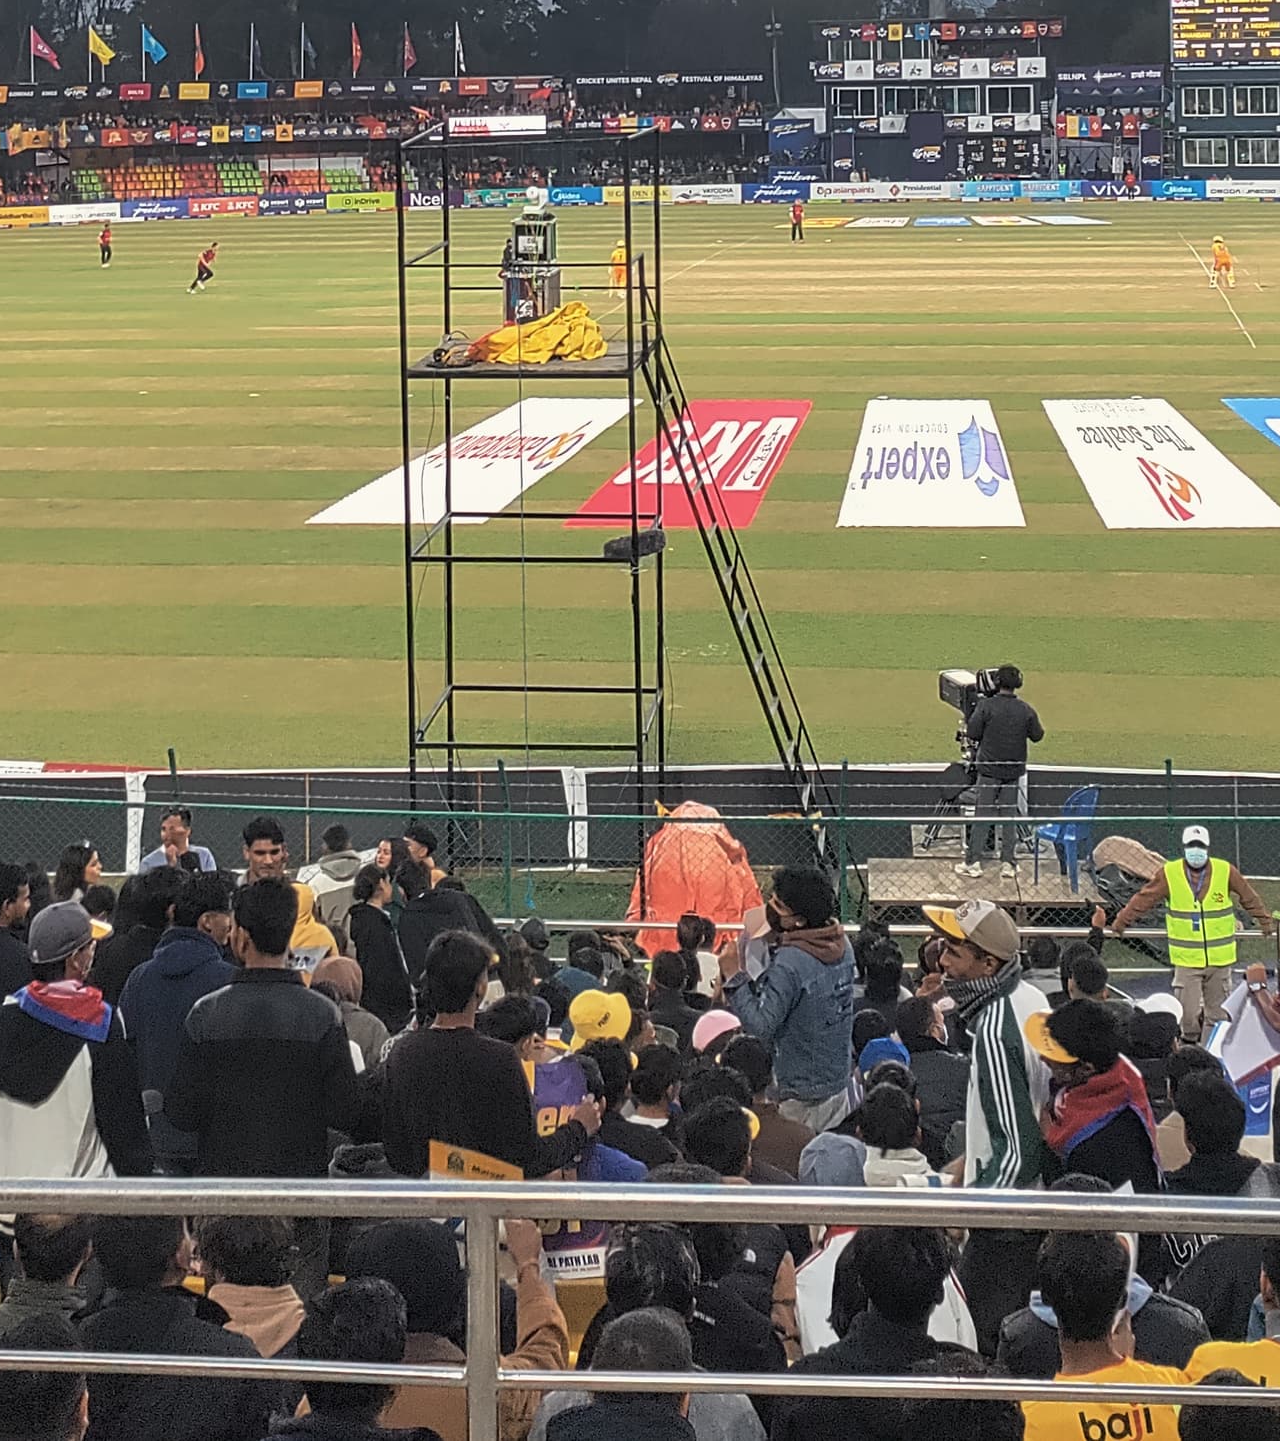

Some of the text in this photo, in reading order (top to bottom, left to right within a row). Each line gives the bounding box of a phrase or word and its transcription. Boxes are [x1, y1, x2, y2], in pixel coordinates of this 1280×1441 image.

[576, 76, 653, 84] CRICKET UNITES NEPAL
[681, 75, 712, 83] FESTIVAL
[724, 74, 763, 82] HIMALAYAS
[833, 187, 875, 196] asianpaints
[903, 184, 942, 192] Presidential
[353, 196, 381, 205] inDrive
[410, 191, 446, 206] Ncel
[200, 202, 220, 211] KFC
[235, 201, 255, 210] KFC
[1076, 423, 1195, 452] The Soaltee
[861, 441, 951, 490] expert
[560, 1255, 581, 1267] PATH
[582, 1254, 600, 1266] LAB
[1078, 1404, 1154, 1441] baji
